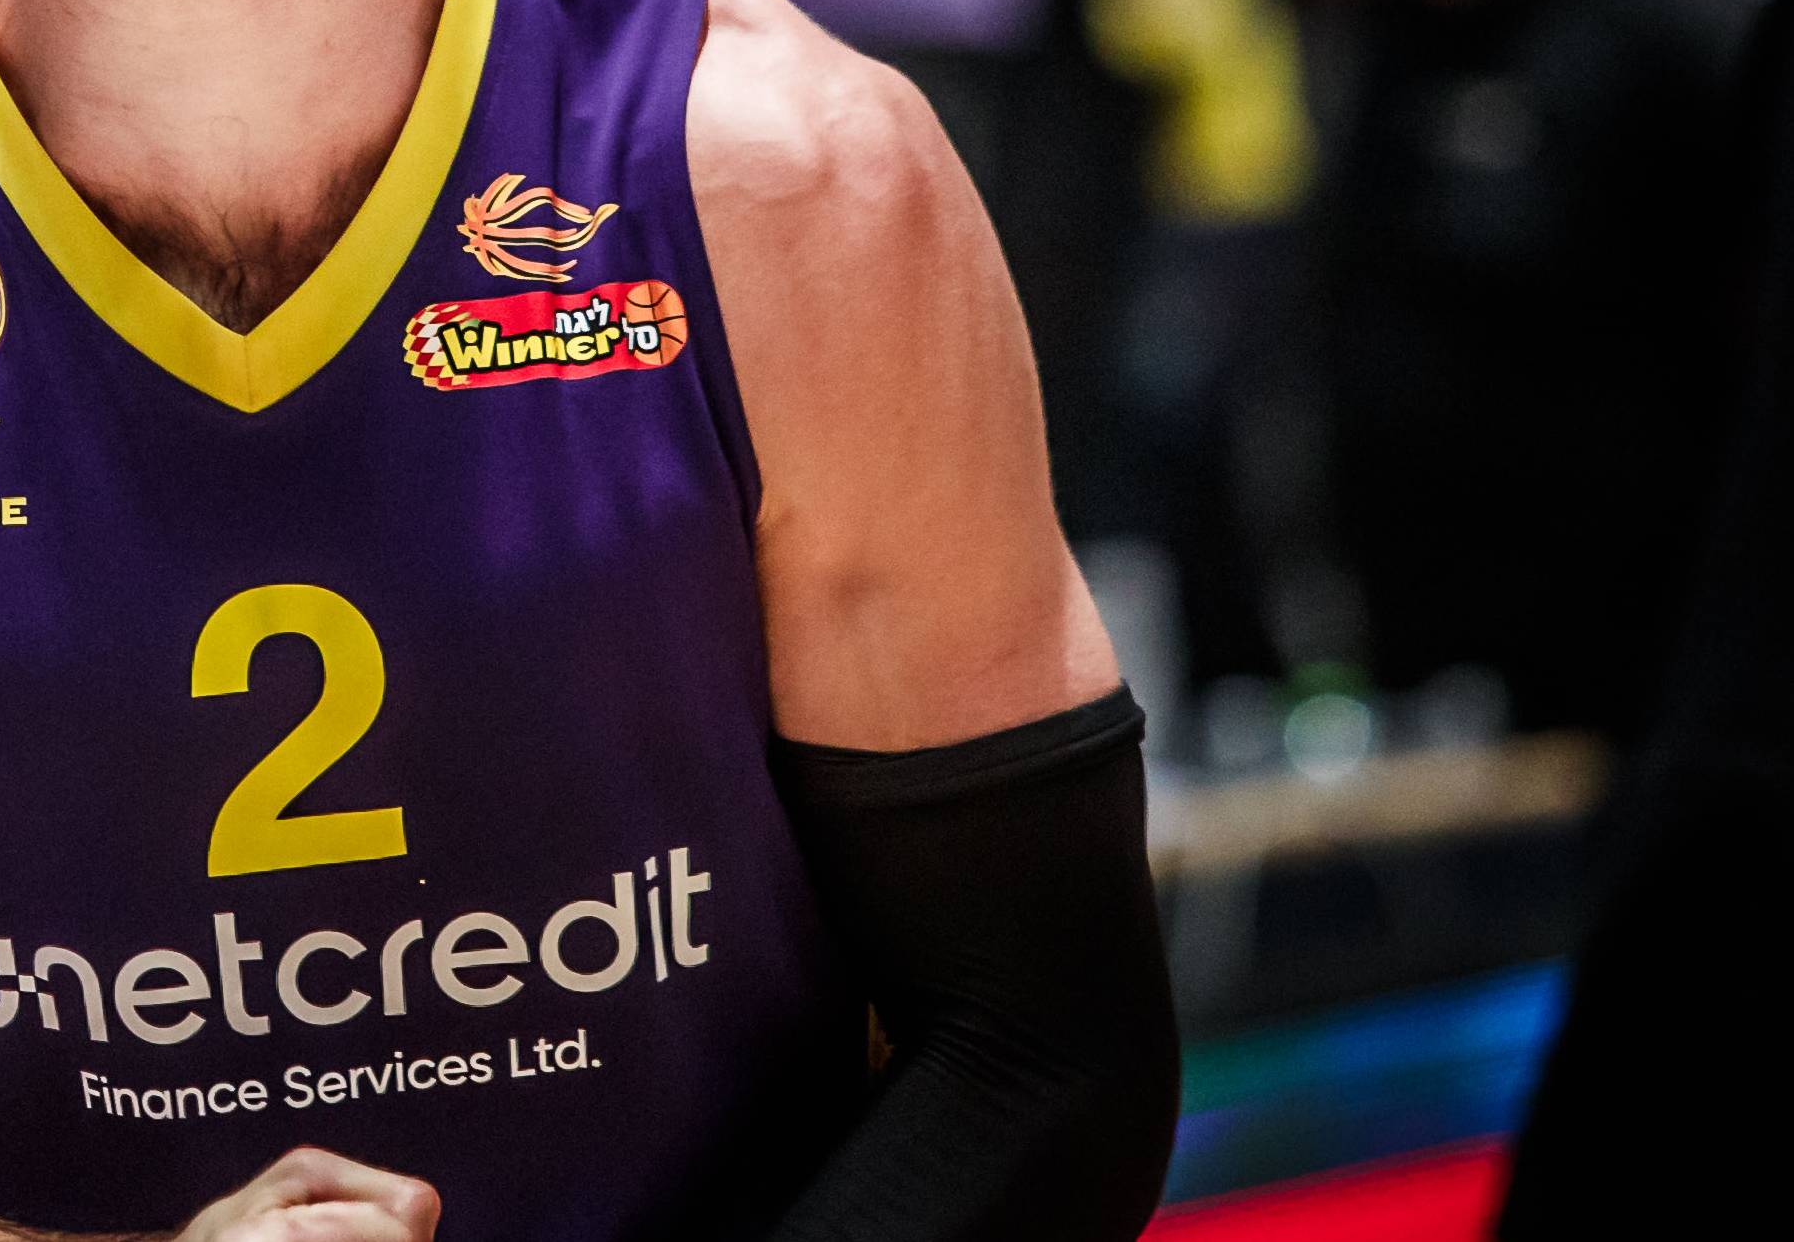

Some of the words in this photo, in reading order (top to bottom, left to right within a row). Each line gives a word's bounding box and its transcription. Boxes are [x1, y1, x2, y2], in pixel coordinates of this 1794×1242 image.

[442, 325, 620, 370] Winner
[621, 317, 659, 350] סל
[191, 584, 408, 878] 2
[80, 1071, 268, 1121] Finance
[284, 1047, 494, 1110] Services
[509, 1028, 603, 1078] Ltd.
